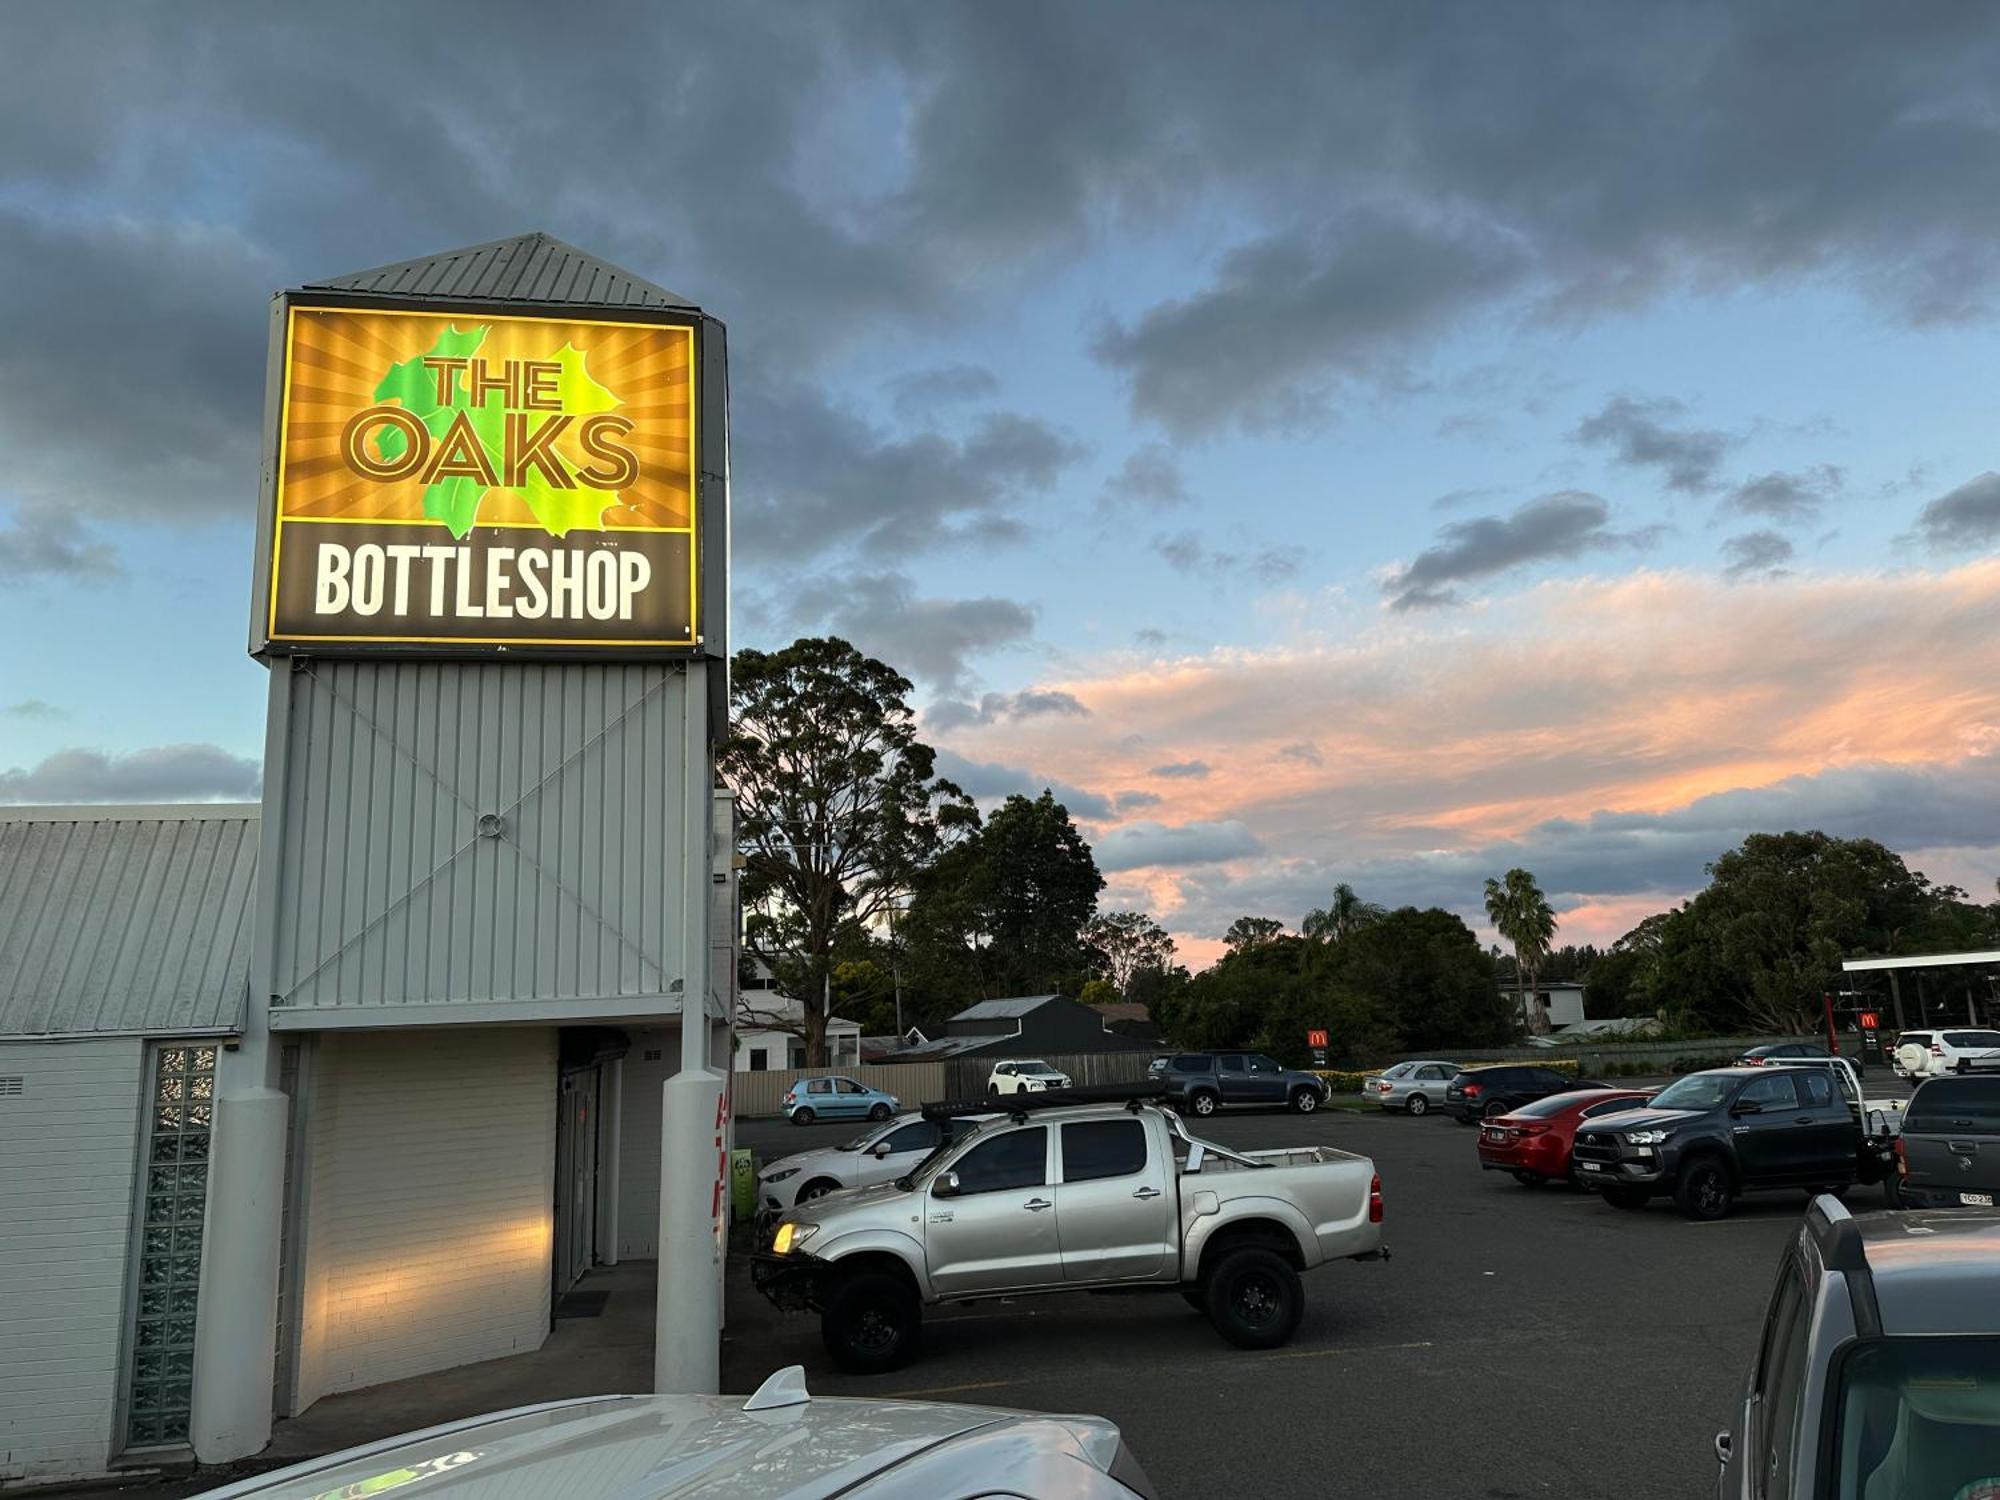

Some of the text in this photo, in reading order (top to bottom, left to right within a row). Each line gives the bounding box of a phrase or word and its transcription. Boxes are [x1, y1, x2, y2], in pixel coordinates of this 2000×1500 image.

[423, 356, 563, 412] THE
[339, 404, 641, 491] OAKS
[314, 542, 652, 621] BOTTLESHOP
